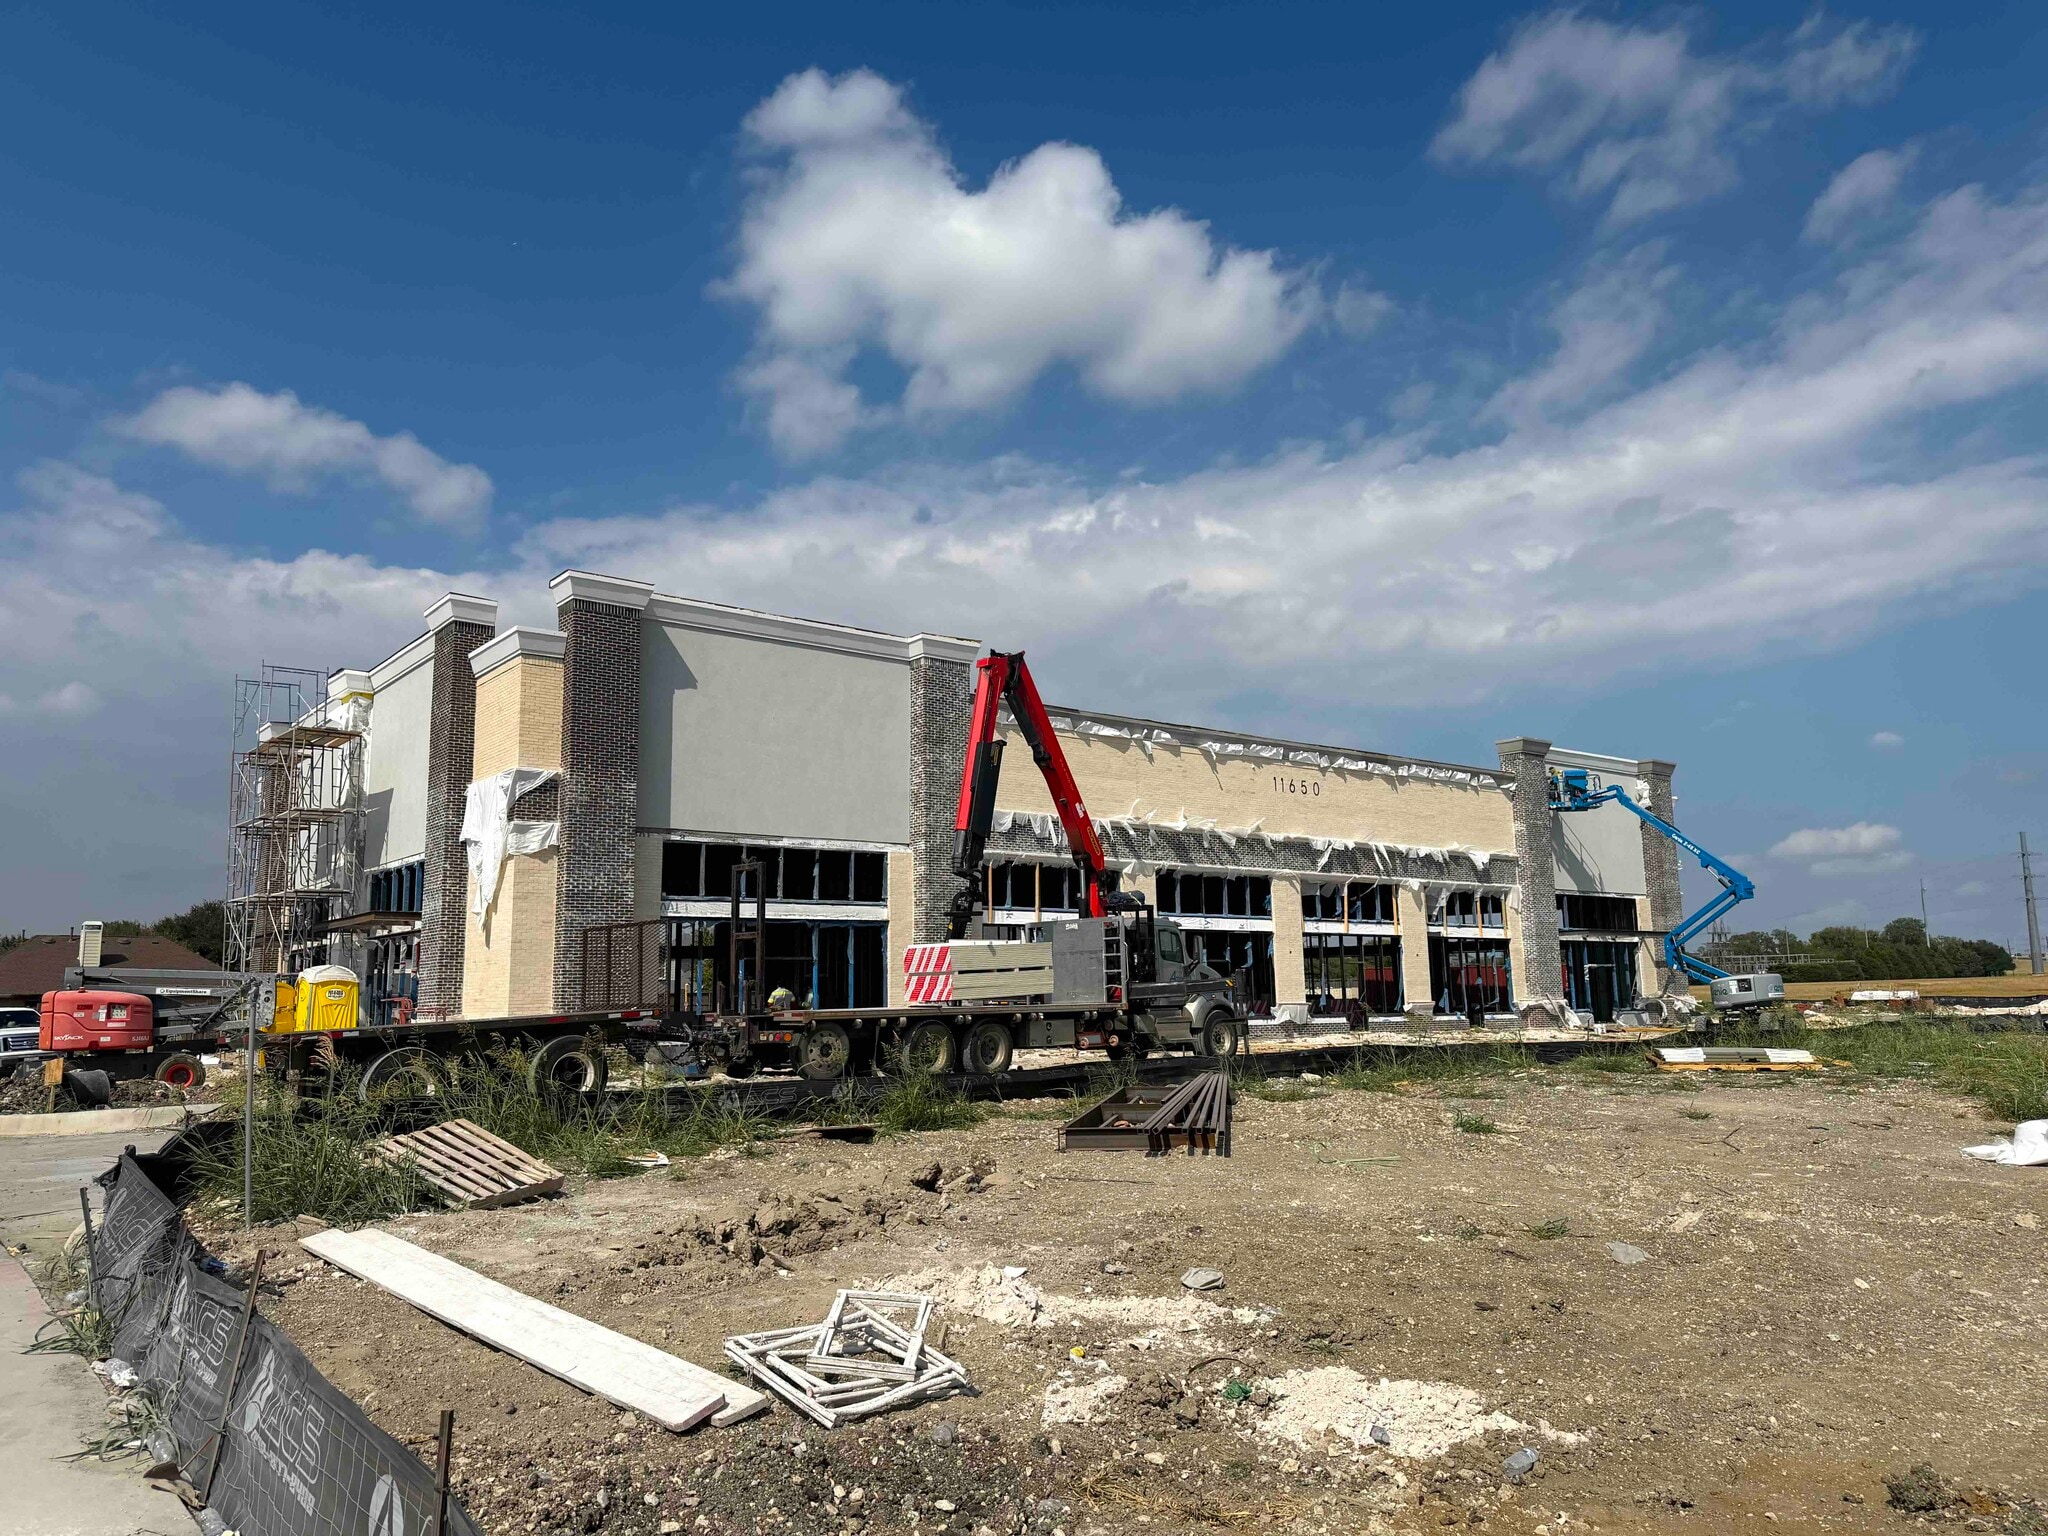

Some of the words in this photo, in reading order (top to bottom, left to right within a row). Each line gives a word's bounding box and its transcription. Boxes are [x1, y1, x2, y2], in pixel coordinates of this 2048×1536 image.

[1273, 776, 1320, 796] 11650
[54, 1034, 84, 1042] SKYJACK
[747, 1086, 798, 1105] ACS
[259, 1374, 325, 1484] ACS
